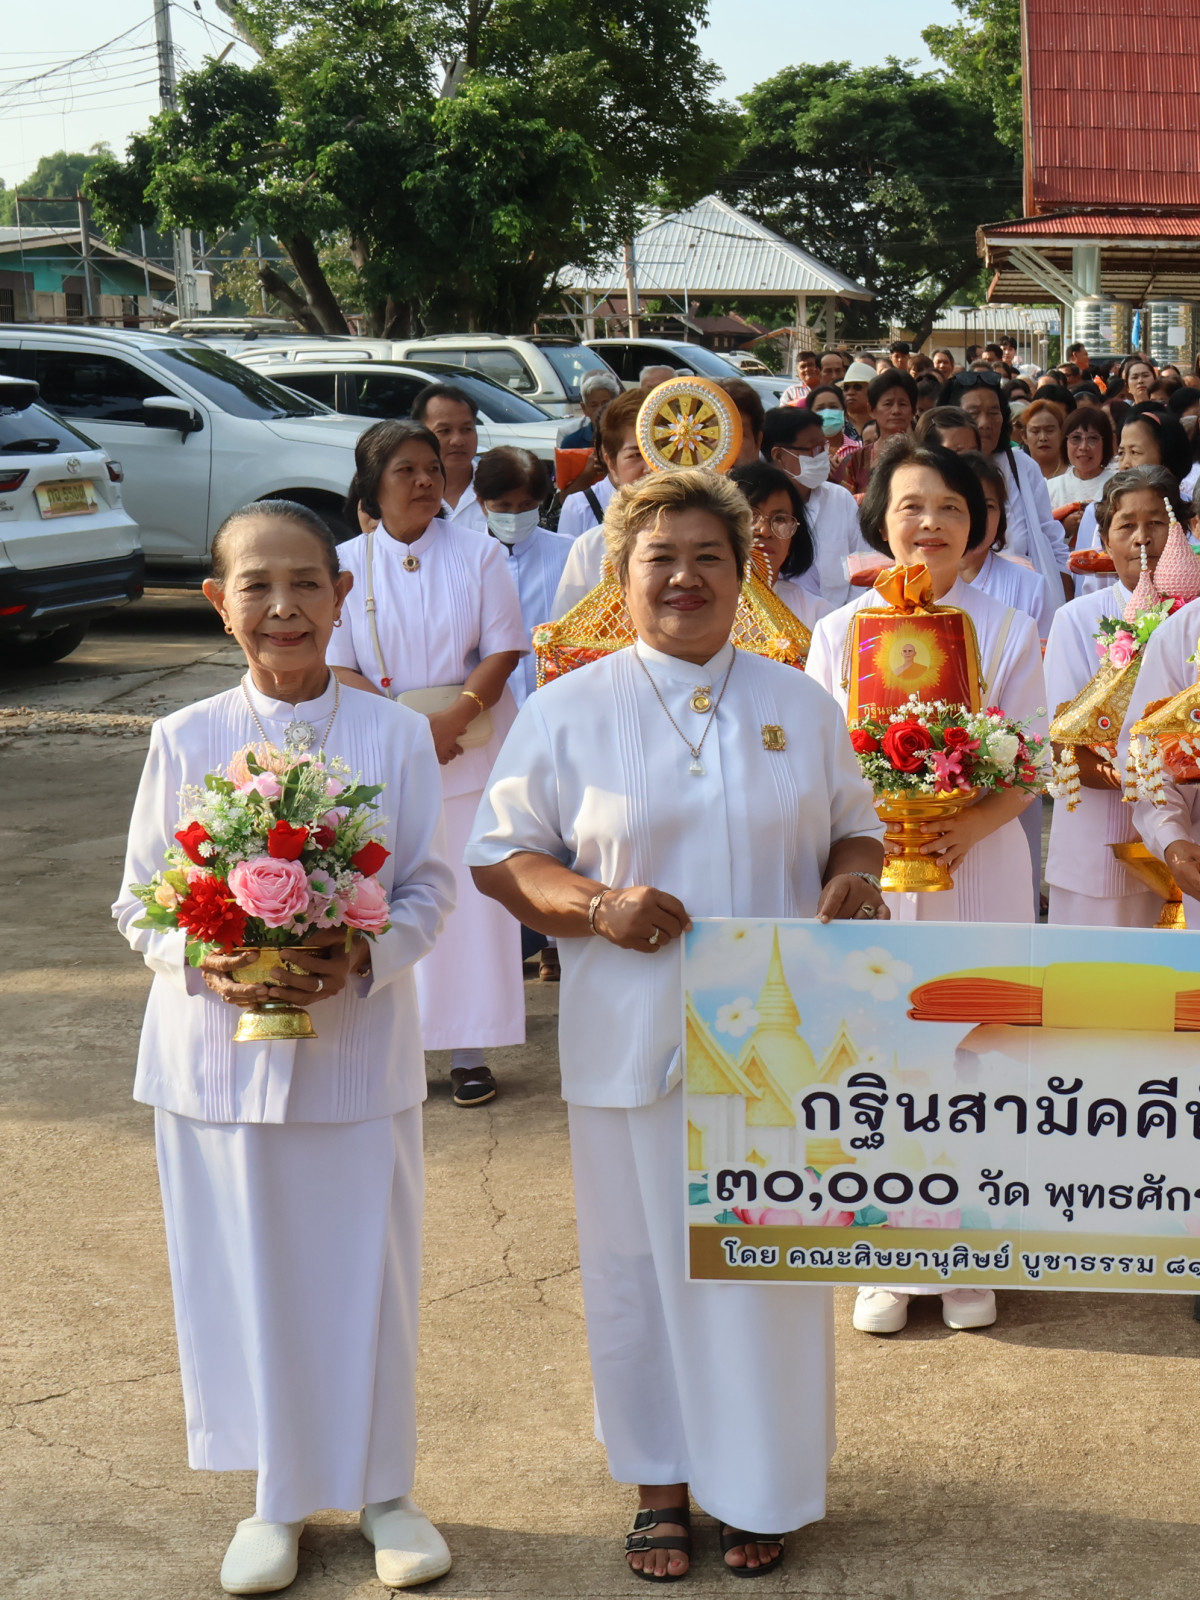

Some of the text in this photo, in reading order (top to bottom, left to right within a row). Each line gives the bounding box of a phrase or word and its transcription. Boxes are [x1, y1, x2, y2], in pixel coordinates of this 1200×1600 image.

[715, 1167, 960, 1212] ๓๐,๐๐๐
[978, 1168, 1030, 1207] วัด
[724, 1240, 776, 1264] โดย
[790, 1243, 1010, 1276] คณะศิษยานุศิษย์
[1022, 1254, 1153, 1278] บูชาธรรม
